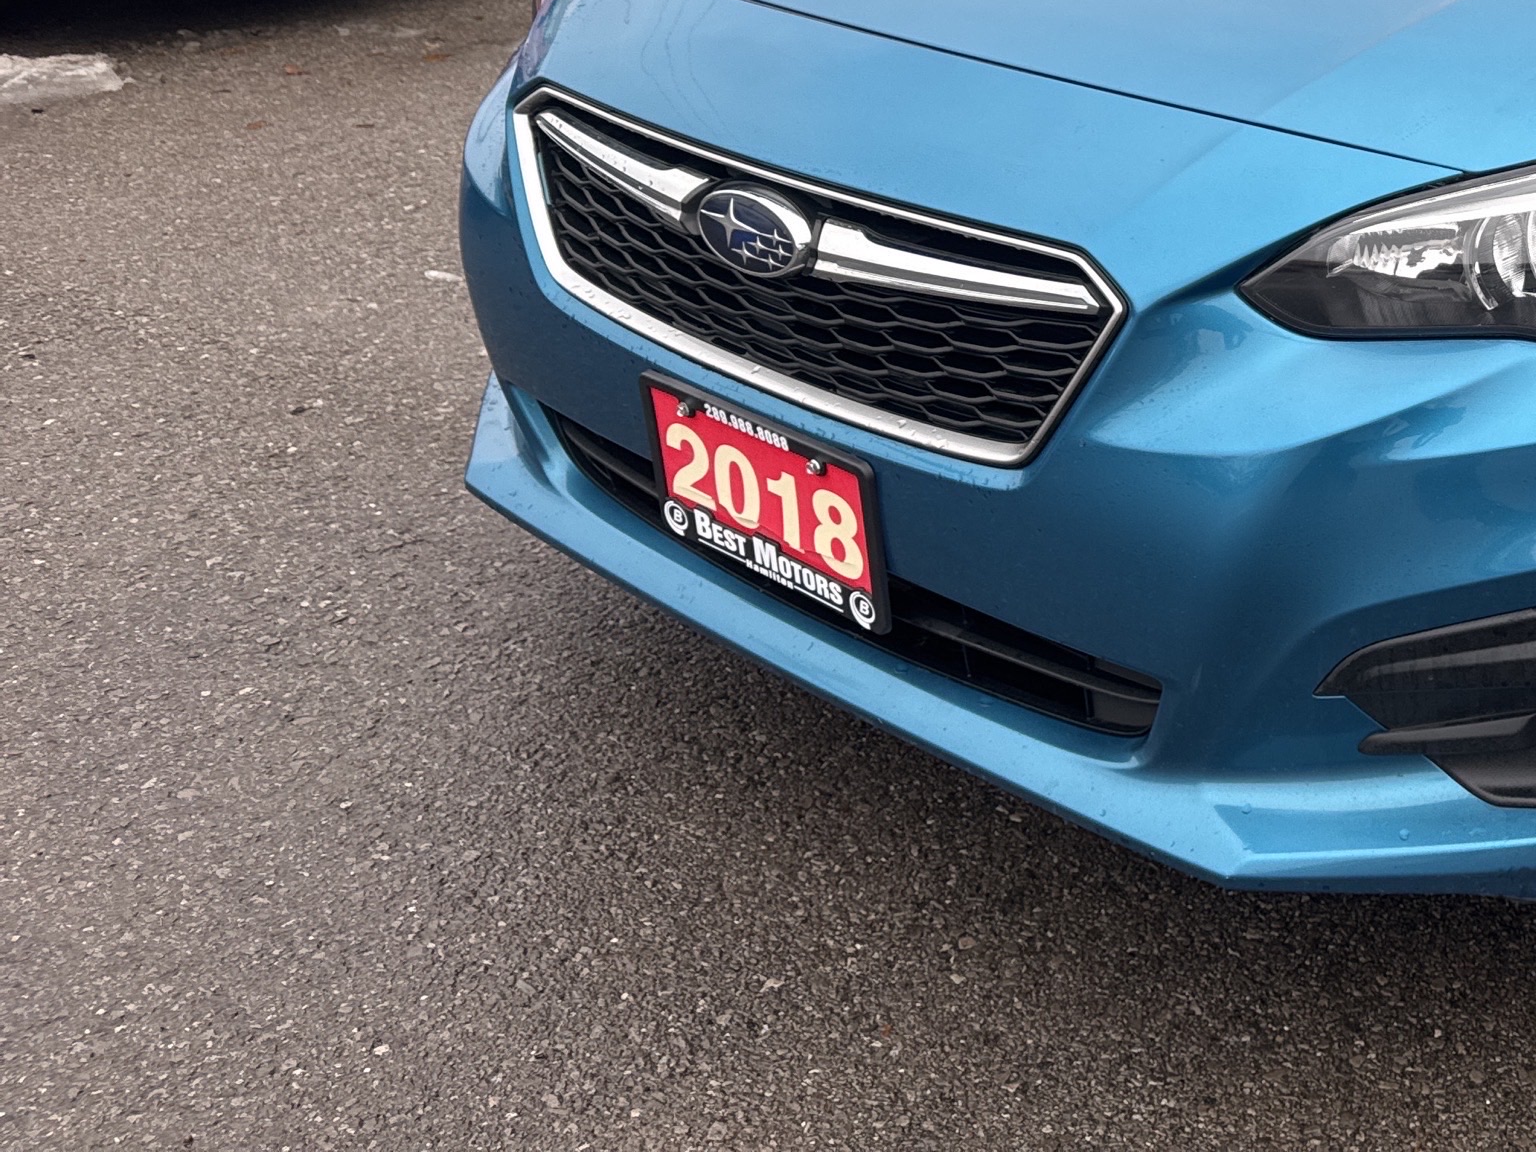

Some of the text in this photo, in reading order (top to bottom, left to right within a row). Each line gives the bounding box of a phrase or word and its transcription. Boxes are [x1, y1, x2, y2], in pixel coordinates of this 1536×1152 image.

[665, 422, 864, 581] 2018
[693, 508, 845, 606] BEST MOTORS
[745, 558, 794, 590] Hamilton
